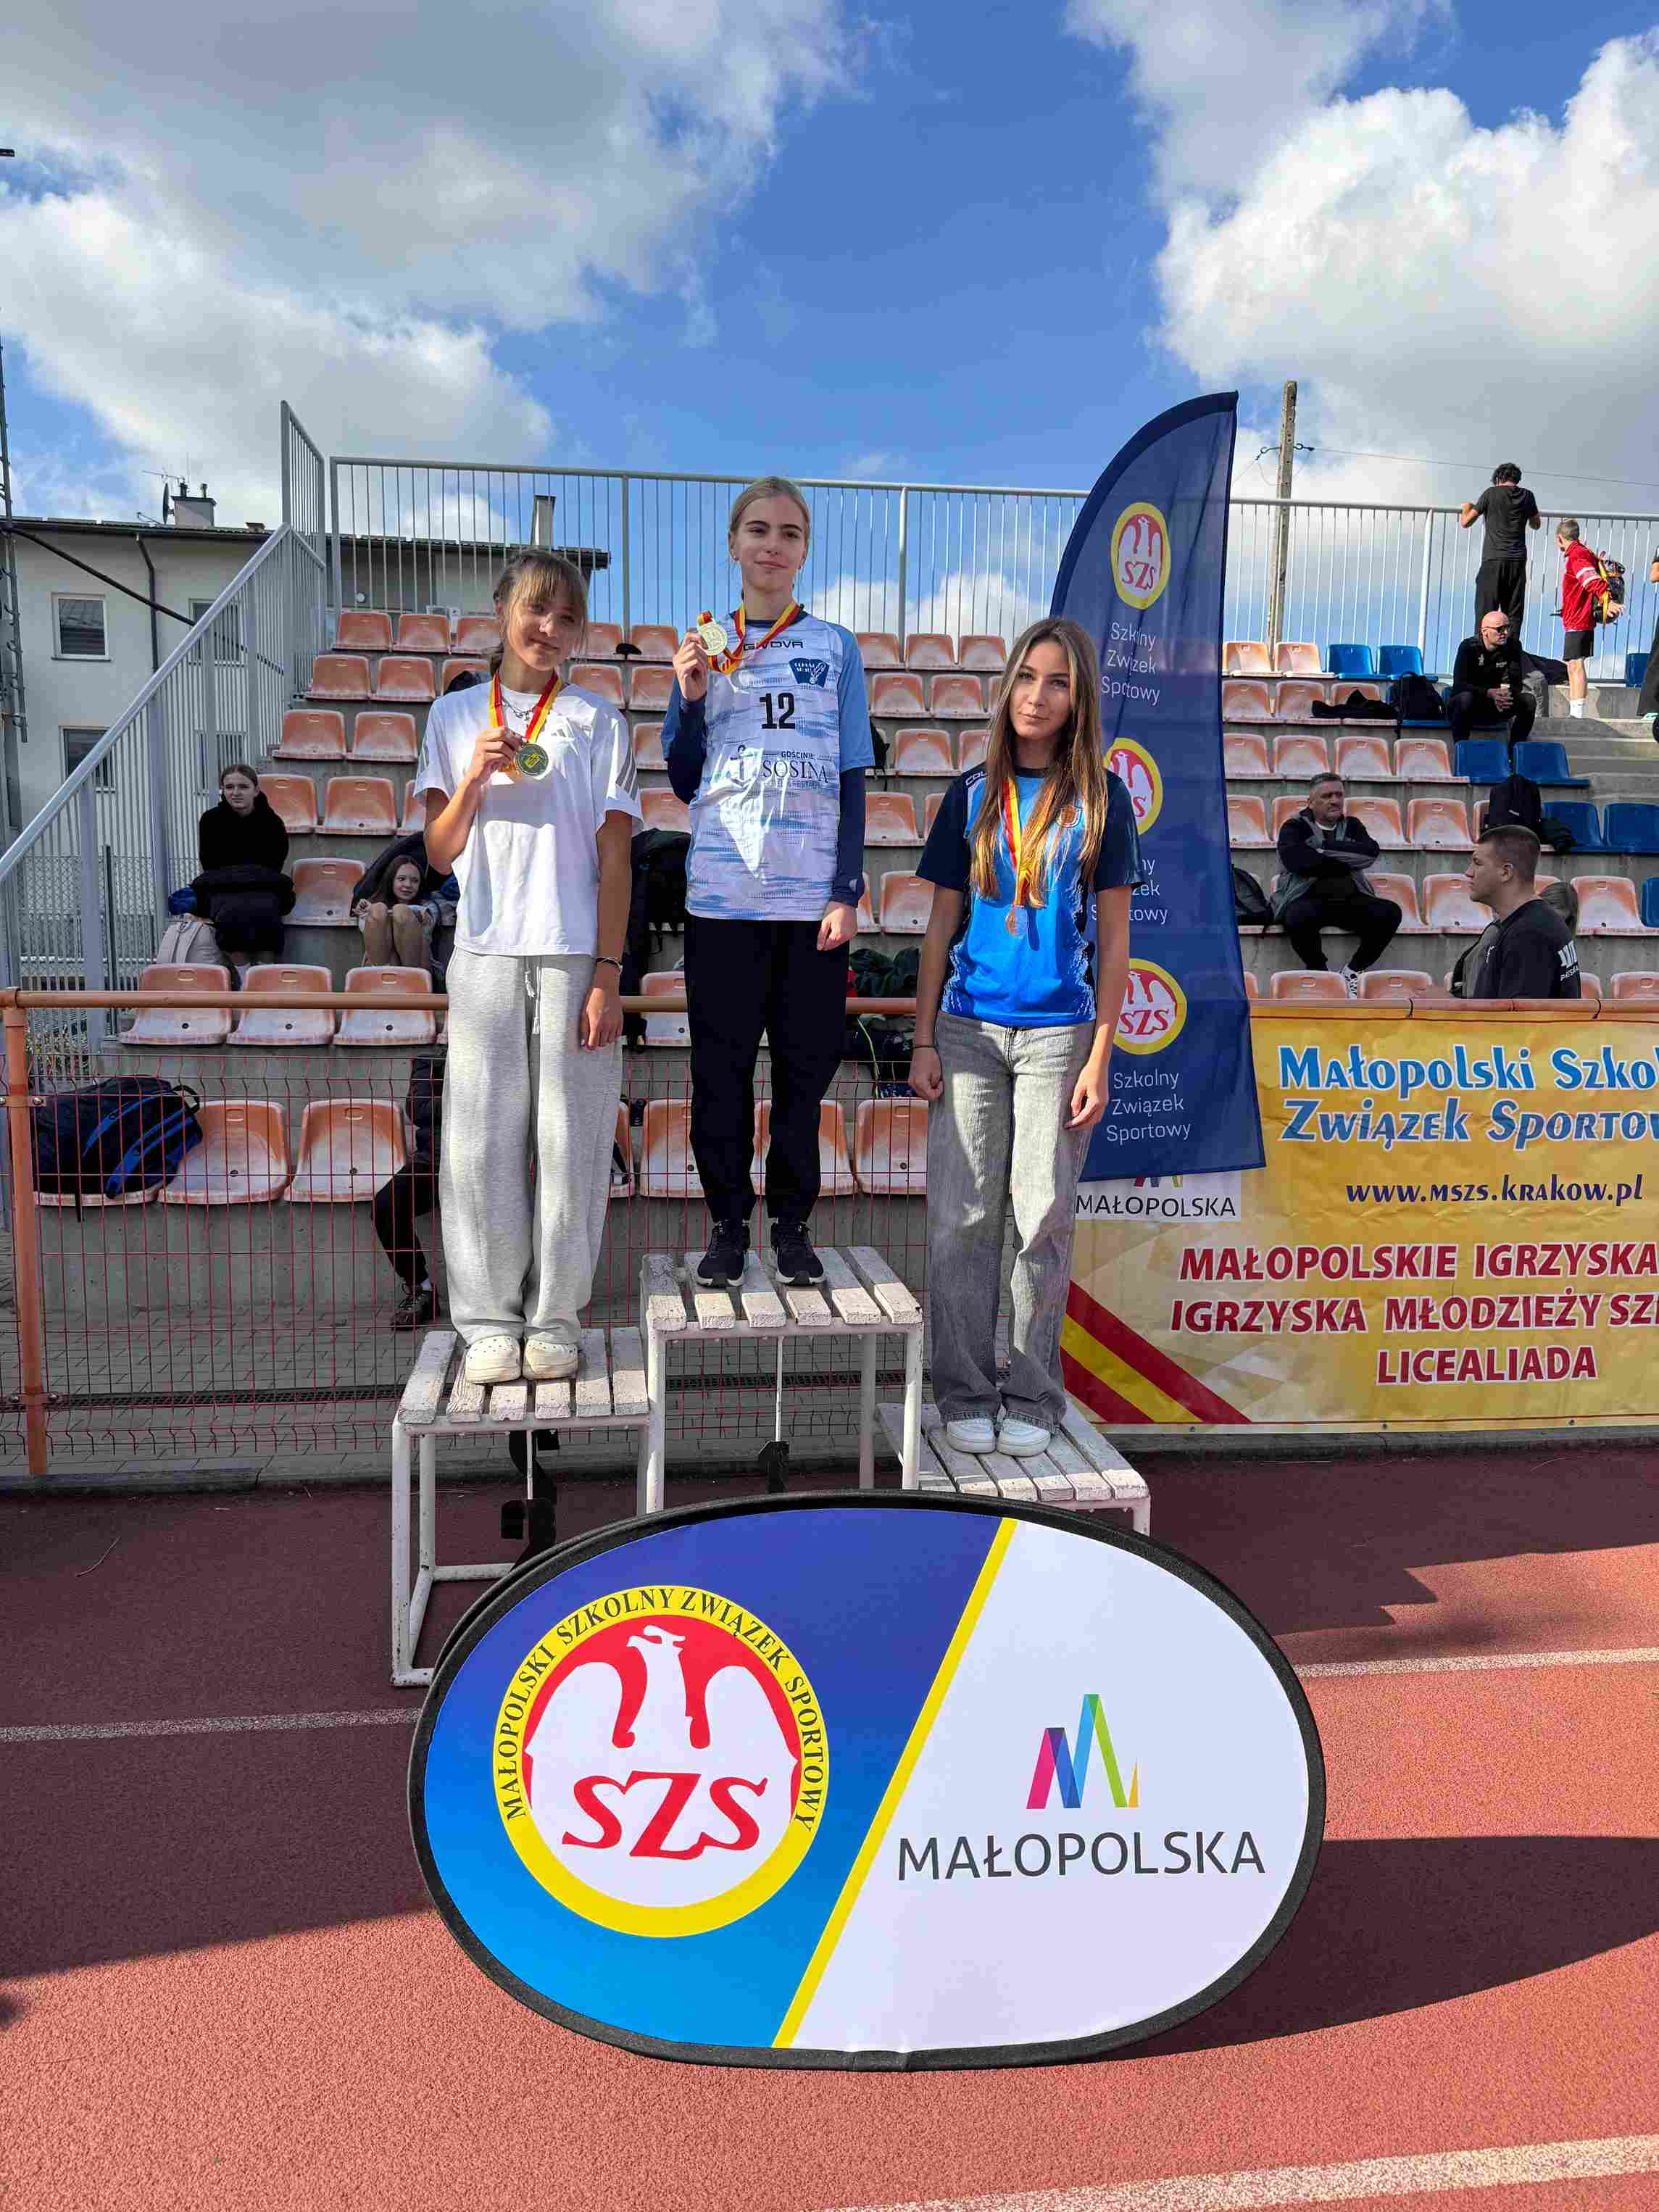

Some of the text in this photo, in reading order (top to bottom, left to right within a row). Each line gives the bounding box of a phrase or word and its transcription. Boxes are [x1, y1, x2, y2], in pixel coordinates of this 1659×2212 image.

[1110, 622, 1156, 652] Szklny
[759, 693, 796, 729] 12
[762, 760, 828, 783] SOSINA
[1119, 1009, 1169, 1035] SZS
[1113, 1068, 1179, 1090] Szkolny
[1551, 1045, 1659, 1089] Szko
[1112, 1093, 1184, 1117] Związek
[1106, 1123, 1191, 1145] Sportowy
[1076, 1194, 1236, 1217] MAŁOPOLSKA
[1180, 1243, 1658, 1281] MAŁOPOLSKIE IGRZYSKA
[1171, 1298, 1368, 1334] IGRZYSKA
[1385, 1288, 1602, 1332] MŁODZIEŻY
[1377, 1346, 1599, 1385] LICEALIADA
[498, 1587, 826, 1832] MAŁOPOLSKI SZKOLNY ZWIĄZEK SPORTOWY
[562, 1770, 768, 1860] SZS
[898, 1831, 1266, 1881] MAŁOPOLSKA
